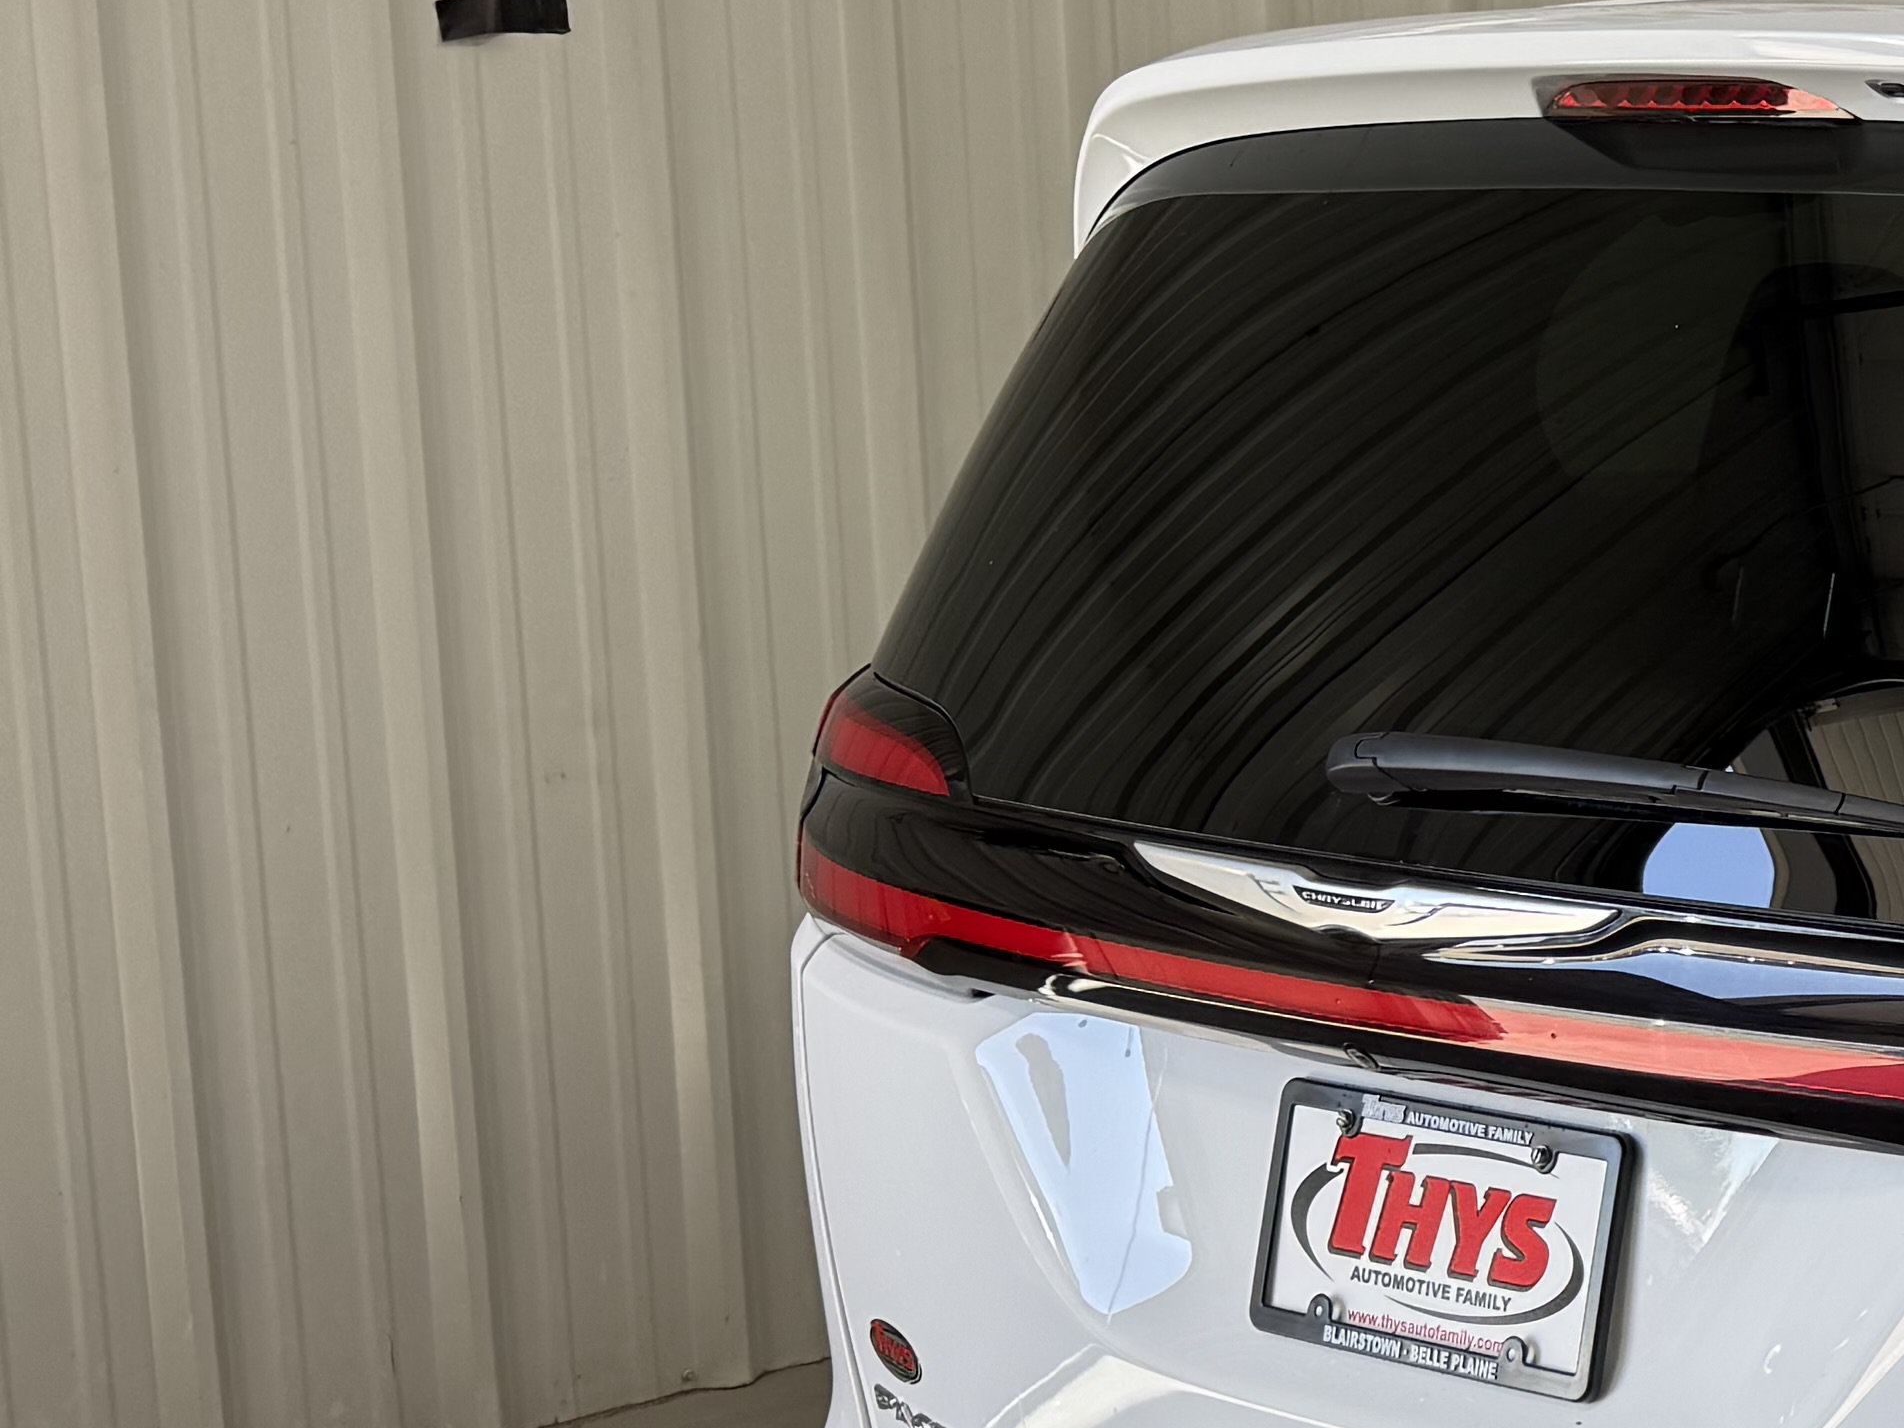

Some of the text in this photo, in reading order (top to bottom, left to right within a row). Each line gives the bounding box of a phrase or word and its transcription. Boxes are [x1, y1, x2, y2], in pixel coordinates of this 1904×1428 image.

[1407, 1111, 1486, 1138] AUTOMOTIVE
[1487, 1125, 1534, 1146] FAMILY
[1328, 1132, 1557, 1291] THYS
[1350, 1265, 1512, 1312] AUTOMOTIVE FAMILY
[1322, 1324, 1498, 1380] BLAIRSTOWN BELLE PLAINE
